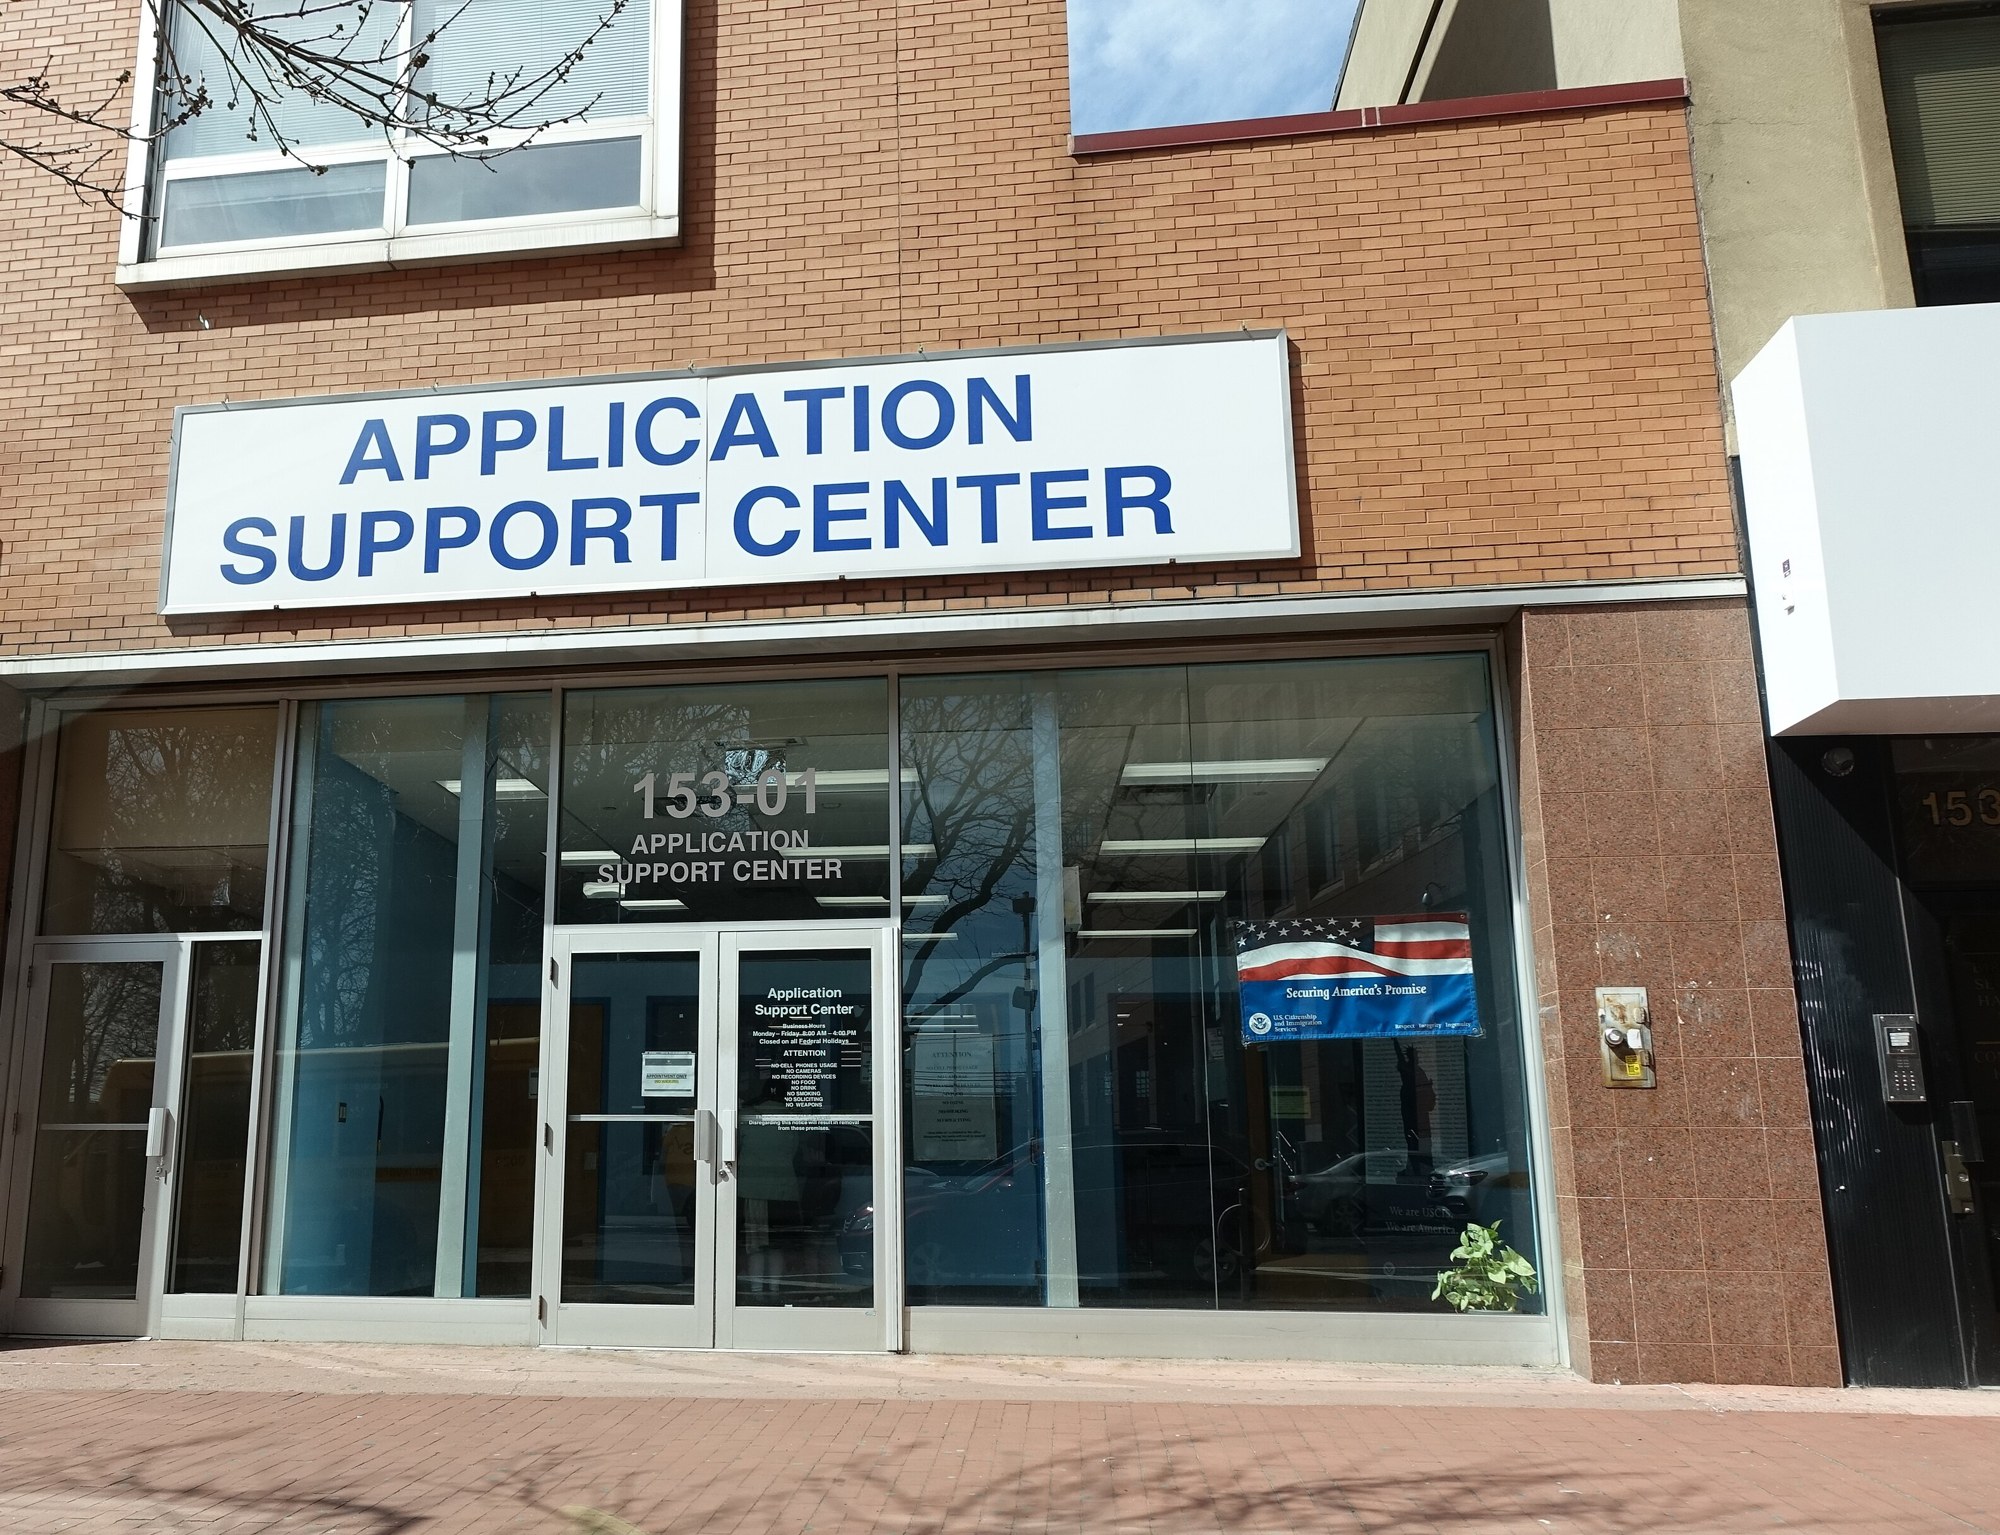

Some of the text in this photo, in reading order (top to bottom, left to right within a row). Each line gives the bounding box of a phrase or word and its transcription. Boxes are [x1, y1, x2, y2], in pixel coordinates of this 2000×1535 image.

[341, 375, 1033, 484] APPLICATION
[220, 466, 1172, 585] SUPPORT CENTER
[633, 768, 816, 819] 153-01
[630, 830, 809, 855] APPLICATION
[597, 858, 843, 885] SUPPORT CENTER
[767, 987, 842, 1001] Application
[1286, 983, 1427, 1001] Securing America's Promise
[754, 1003, 854, 1018] Support Center
[781, 1030, 799, 1038] Friday
[783, 1049, 826, 1057] ATTENTION
[1389, 1205, 1404, 1216] We
[1405, 1208, 1420, 1217] are
[1402, 1223, 1417, 1232] are
